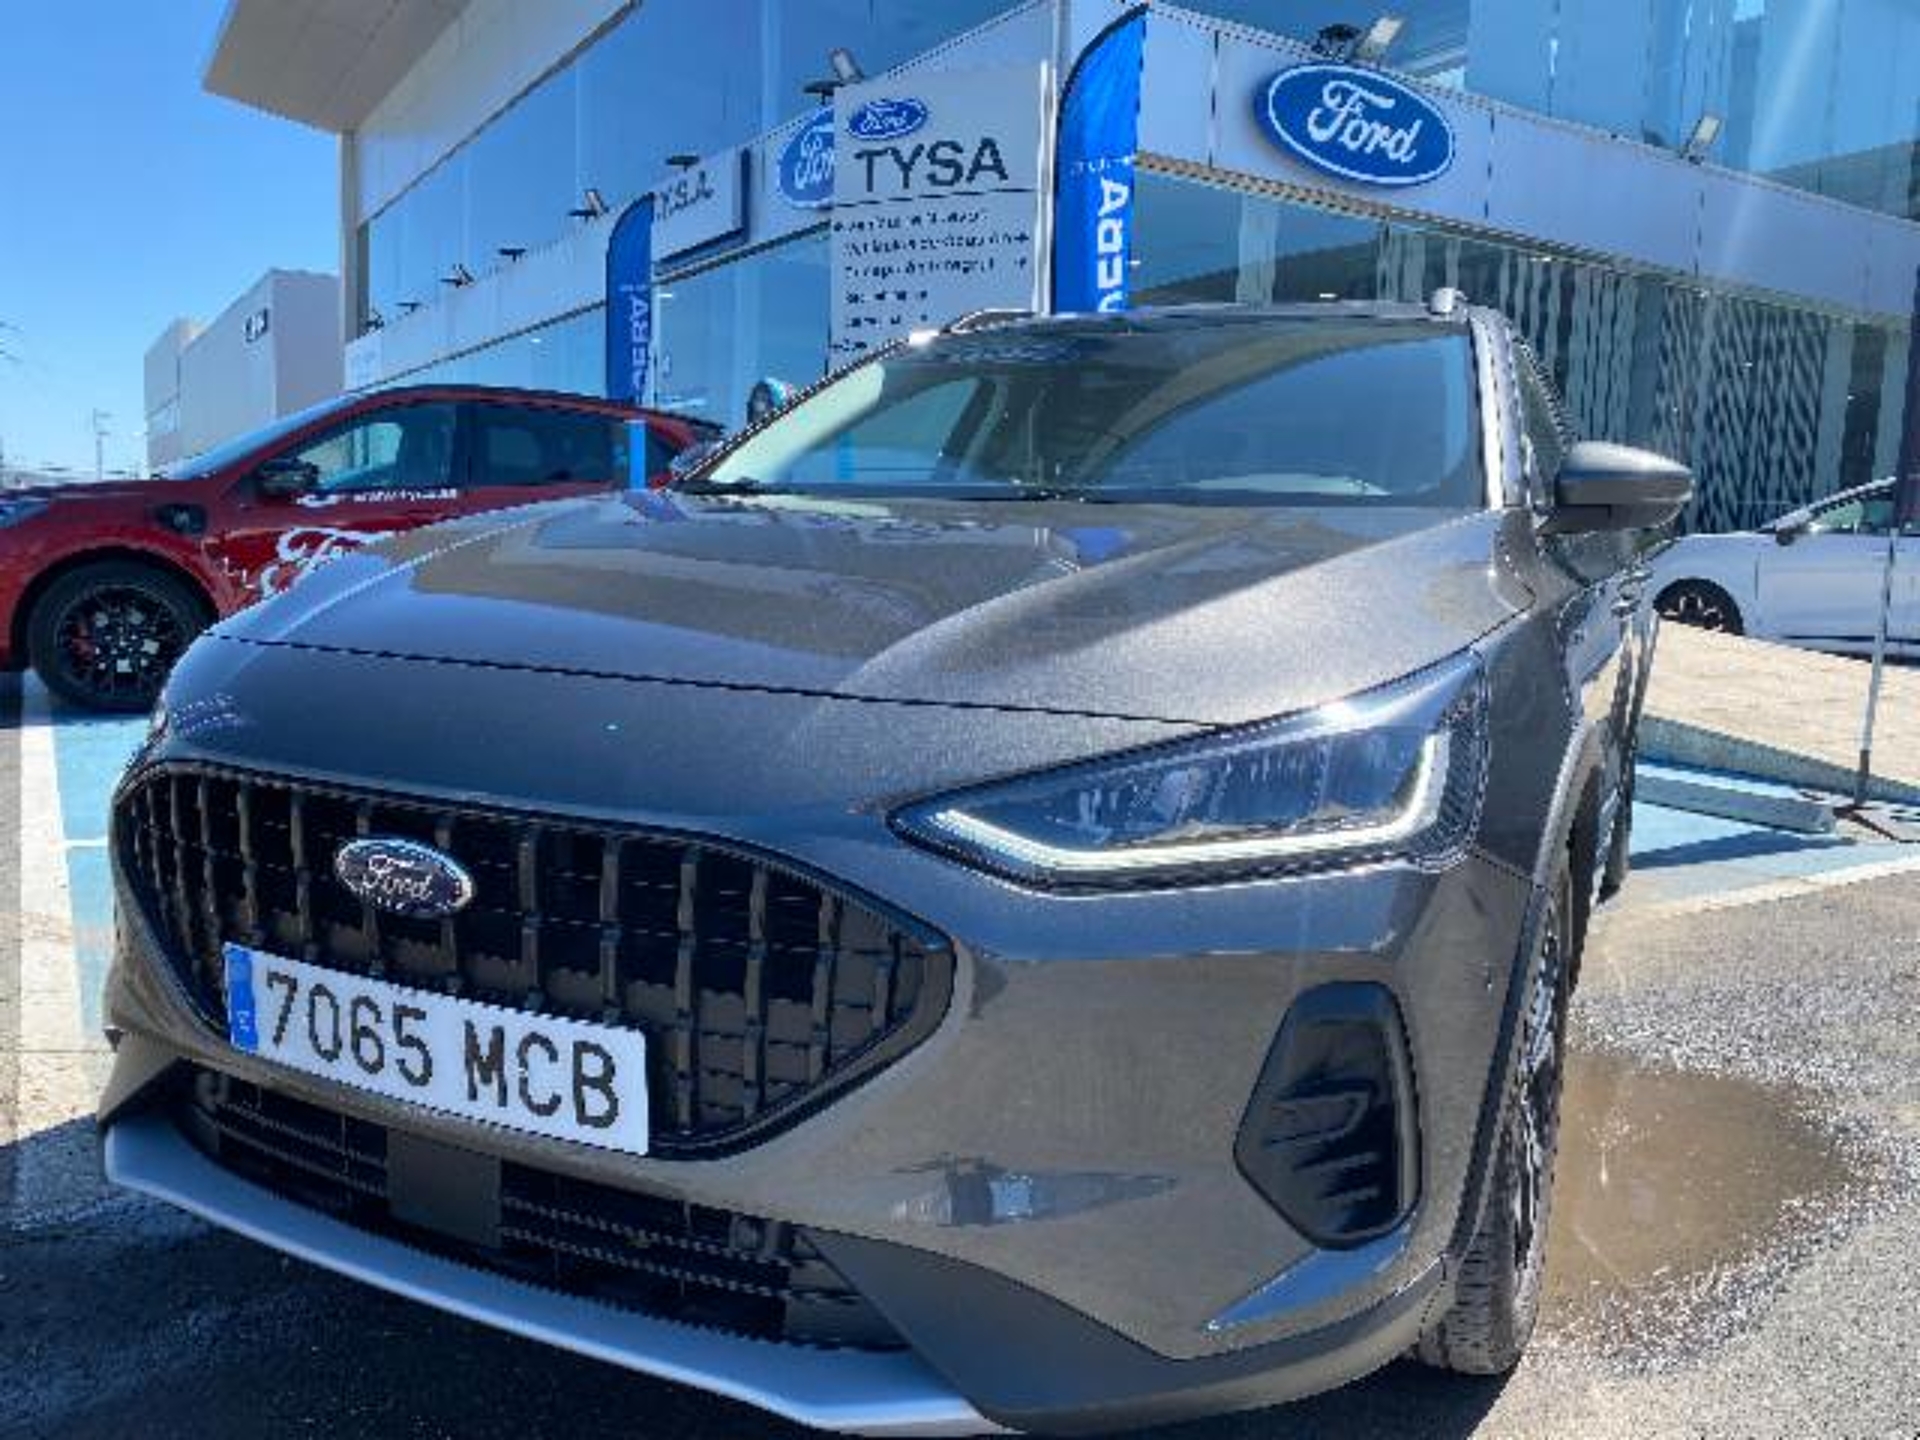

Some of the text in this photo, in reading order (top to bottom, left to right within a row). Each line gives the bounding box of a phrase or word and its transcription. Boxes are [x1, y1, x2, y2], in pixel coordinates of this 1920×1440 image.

[859, 105, 908, 133] Ford
[1307, 79, 1423, 164] Ford
[854, 136, 1009, 192] TYSA
[362, 852, 433, 901] Ford
[266, 970, 620, 1130] 7065 MCB
